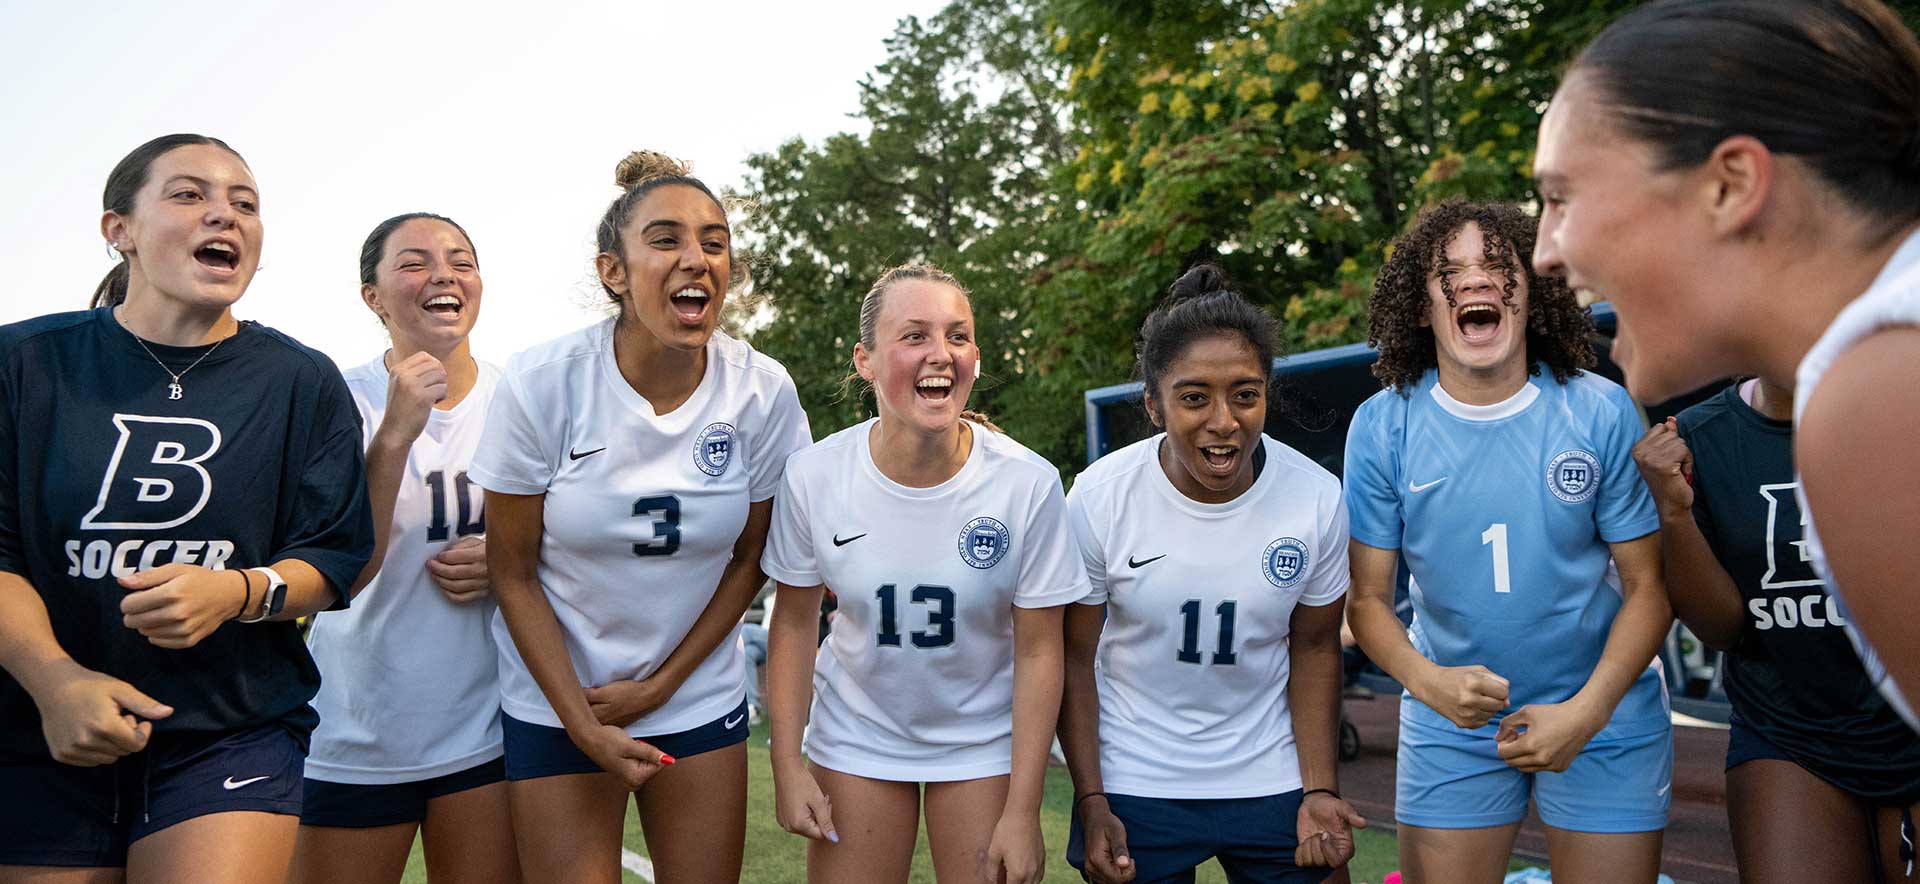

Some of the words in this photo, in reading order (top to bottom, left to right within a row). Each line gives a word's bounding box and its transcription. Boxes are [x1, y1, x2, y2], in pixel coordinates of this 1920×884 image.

[168, 383, 183, 400] B
[80, 413, 222, 530] B
[425, 470, 486, 543] 10
[631, 495, 682, 557] 3
[65, 540, 235, 579] SOCCER
[1482, 523, 1510, 592] 1
[876, 583, 957, 649] 13
[1176, 599, 1238, 665] 11
